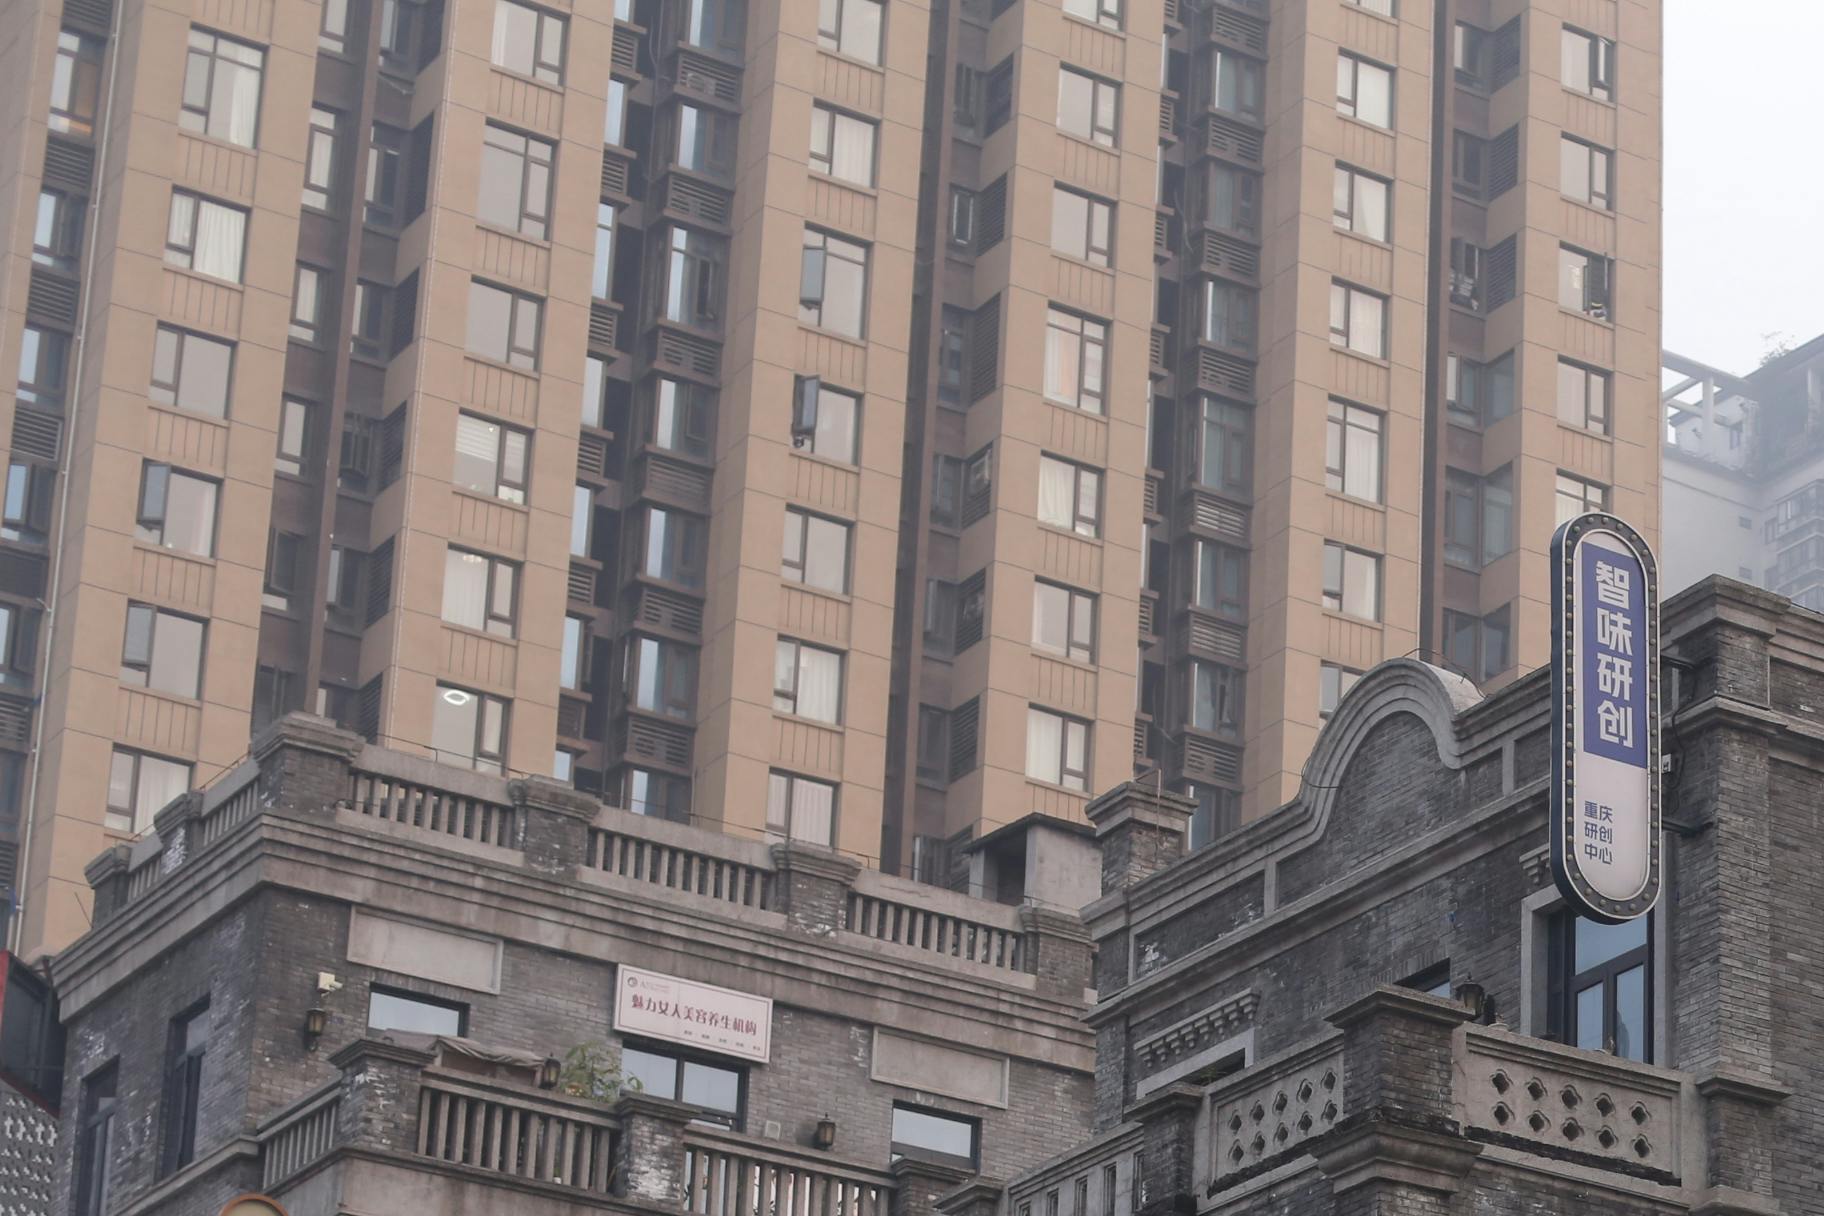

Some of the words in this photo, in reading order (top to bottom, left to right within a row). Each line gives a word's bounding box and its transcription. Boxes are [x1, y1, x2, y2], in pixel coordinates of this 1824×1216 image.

[1595, 560, 1634, 749] 智味研创
[1583, 800, 1613, 824] 重庆
[1583, 821, 1613, 845] 研创
[1583, 843, 1613, 866] 中心
[631, 994, 757, 1036] 魅力女人美容养生机构
